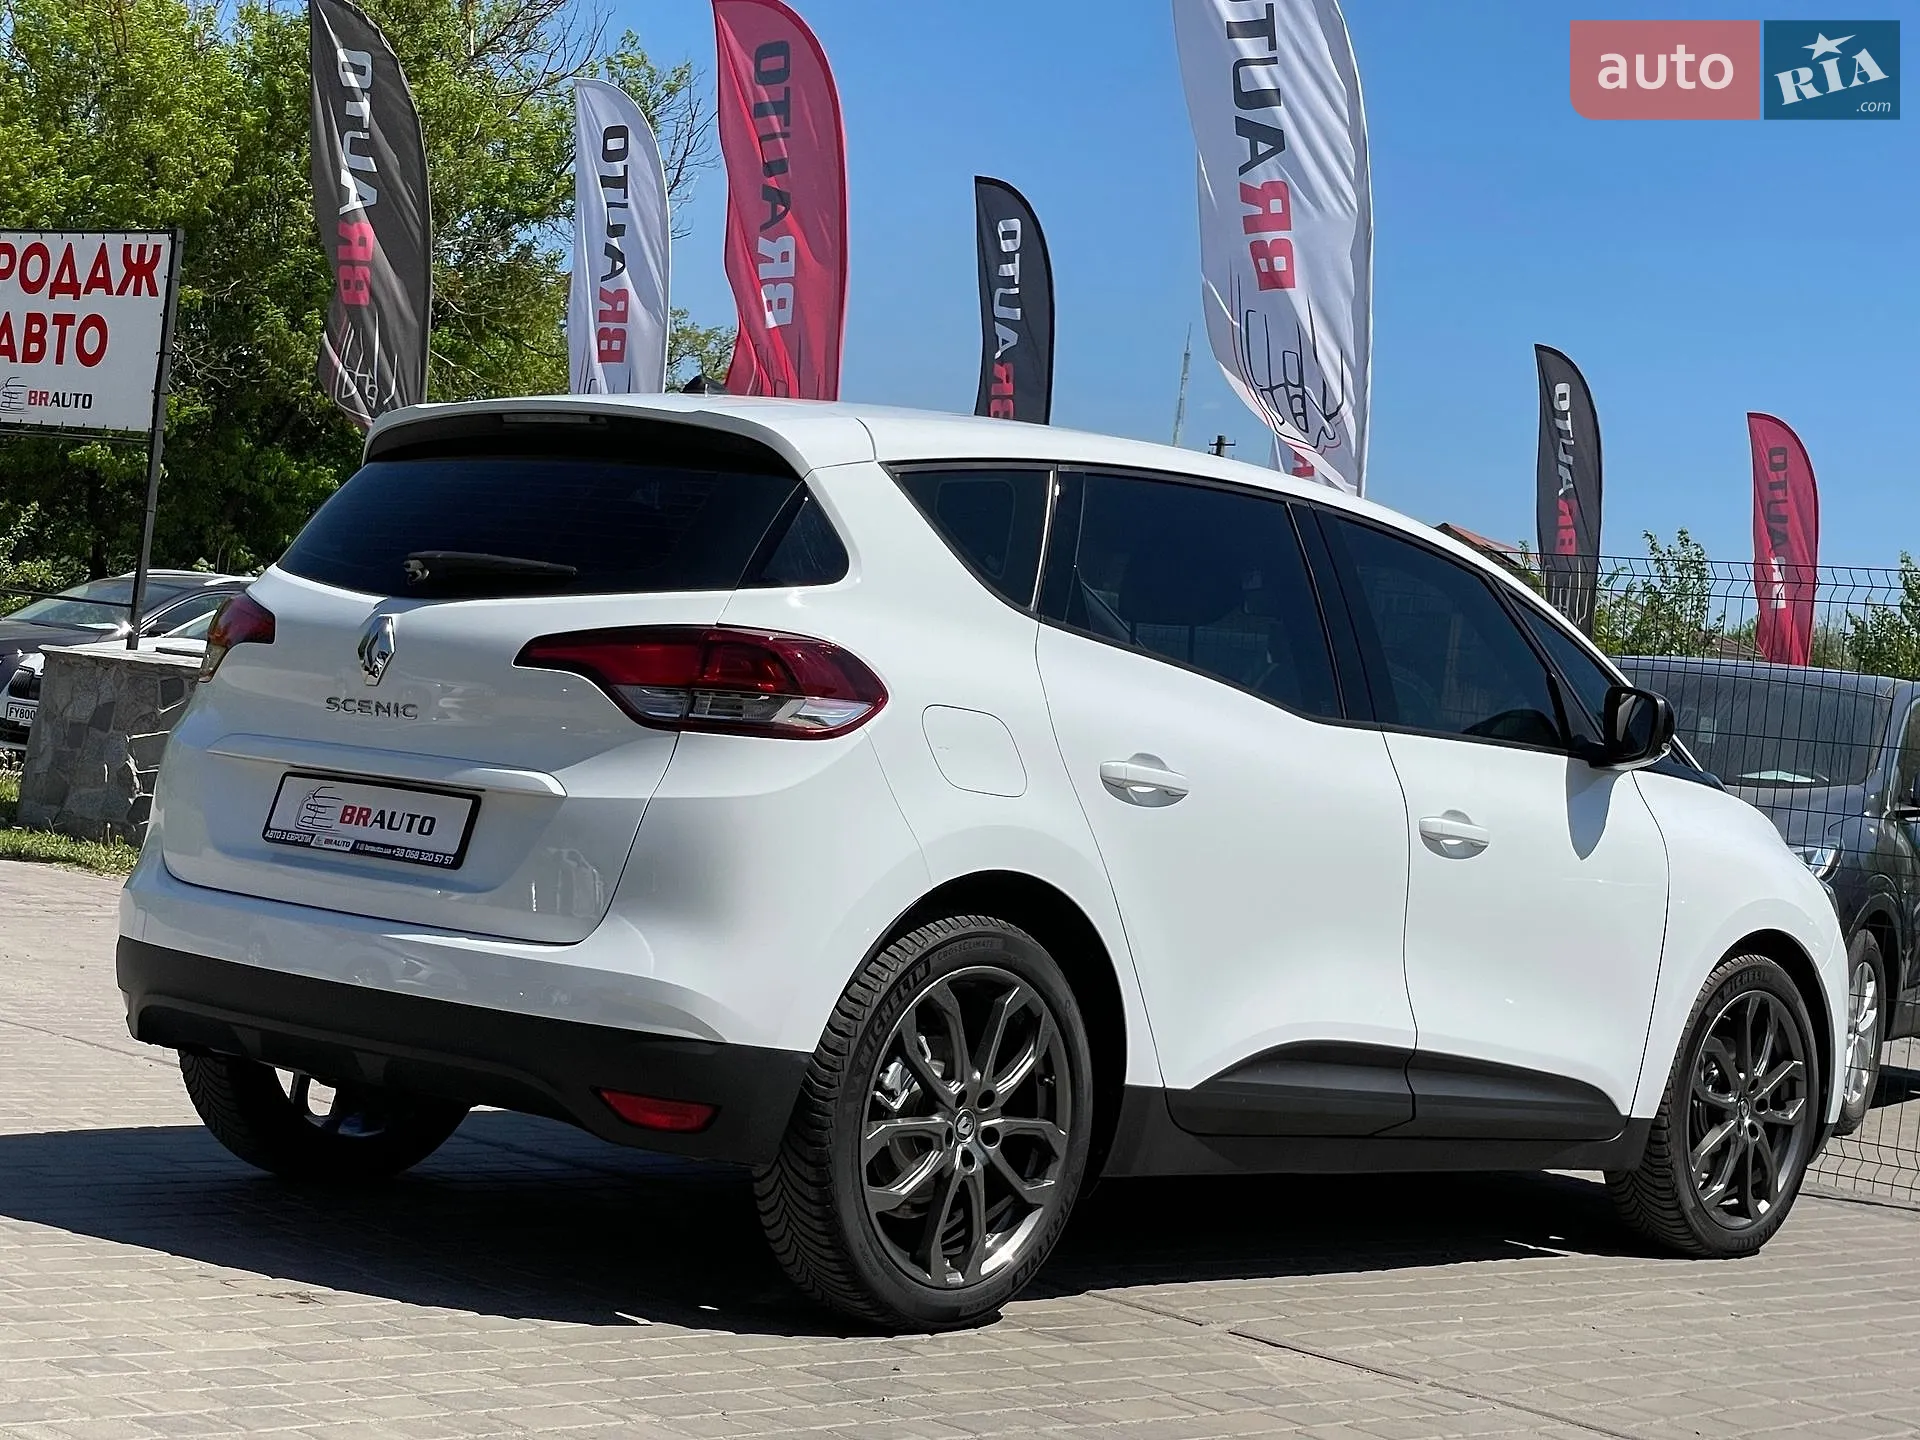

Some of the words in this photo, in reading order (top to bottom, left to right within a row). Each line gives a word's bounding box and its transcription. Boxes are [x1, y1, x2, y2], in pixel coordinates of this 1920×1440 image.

[0, 311, 109, 368] АВТО
[27, 390, 94, 409] BRAUTO
[325, 696, 419, 720] SCENIC
[339, 804, 437, 837] BRAUTO
[264, 829, 282, 840] АВТО
[324, 838, 351, 848] BRAUTO
[420, 852, 434, 862] 320
[858, 958, 931, 1068] MICHELIN
